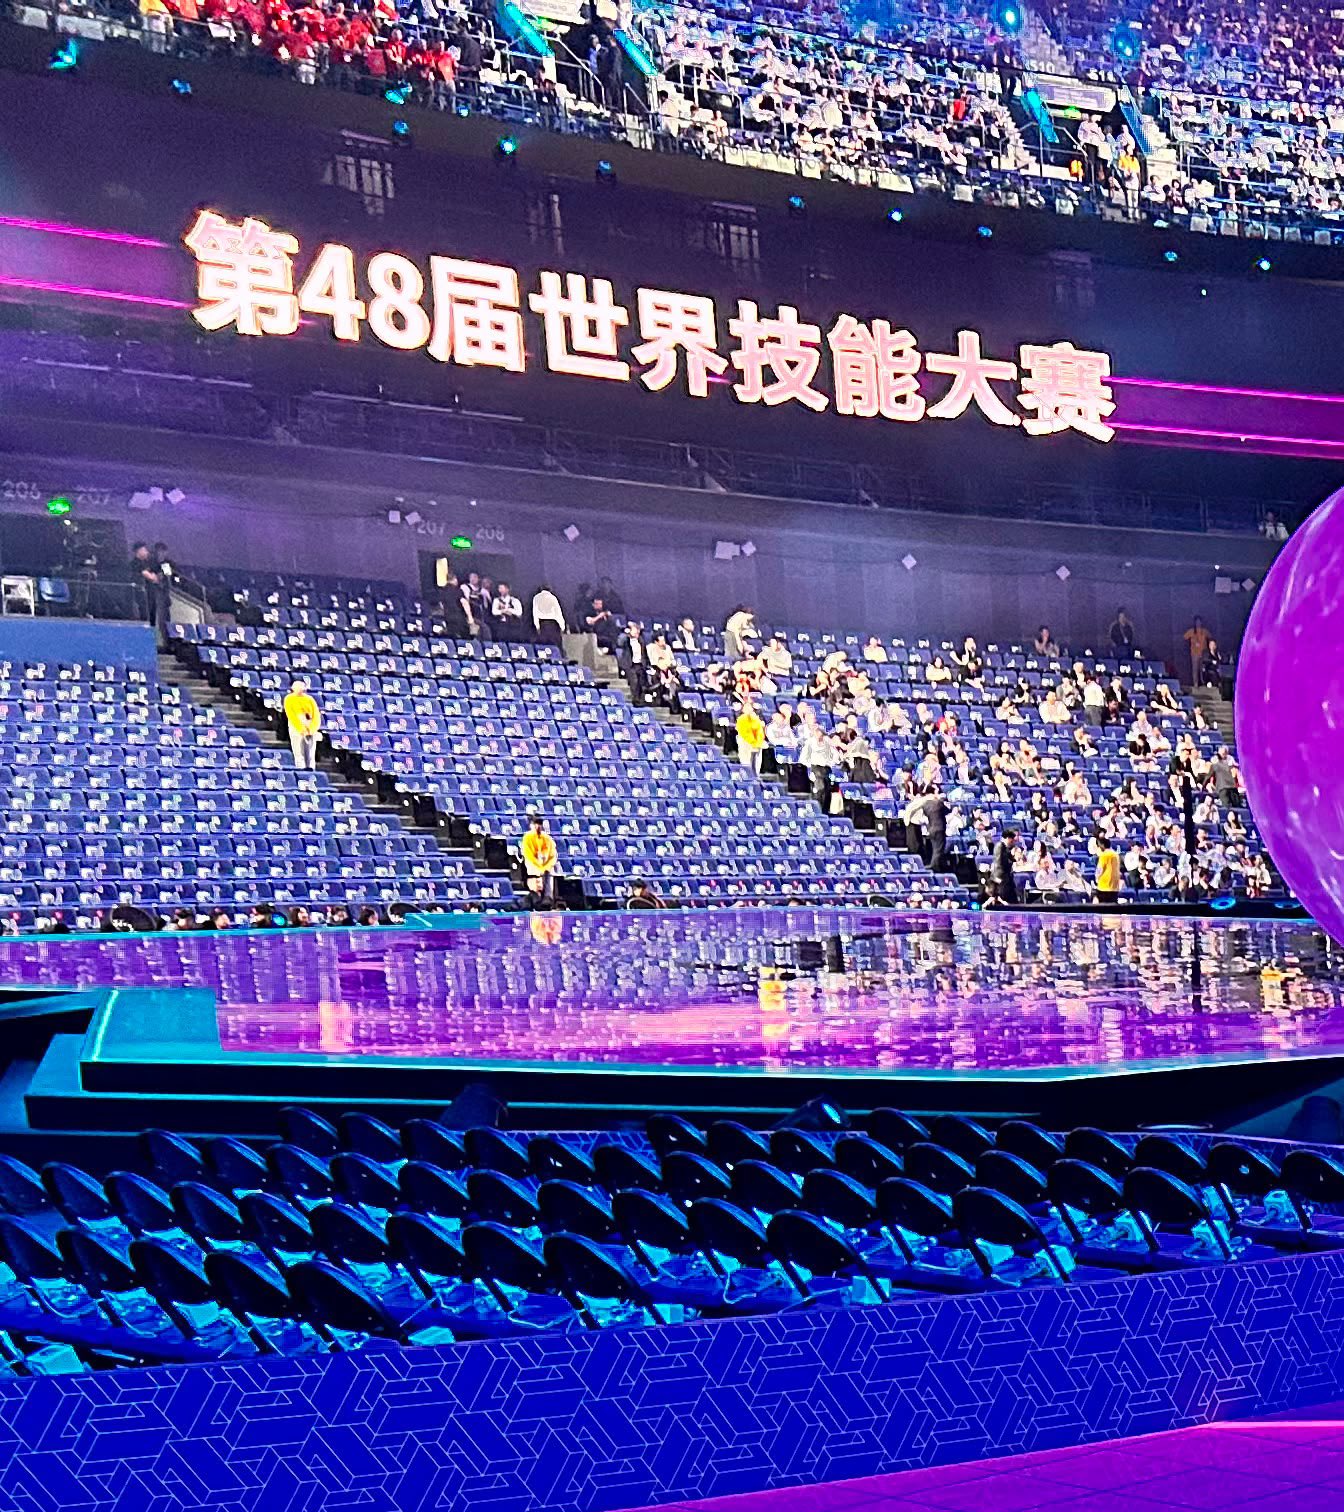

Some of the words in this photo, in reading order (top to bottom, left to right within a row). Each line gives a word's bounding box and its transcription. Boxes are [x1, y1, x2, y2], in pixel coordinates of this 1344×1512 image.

[184, 208, 1116, 444] 第48届世界技能大赛
